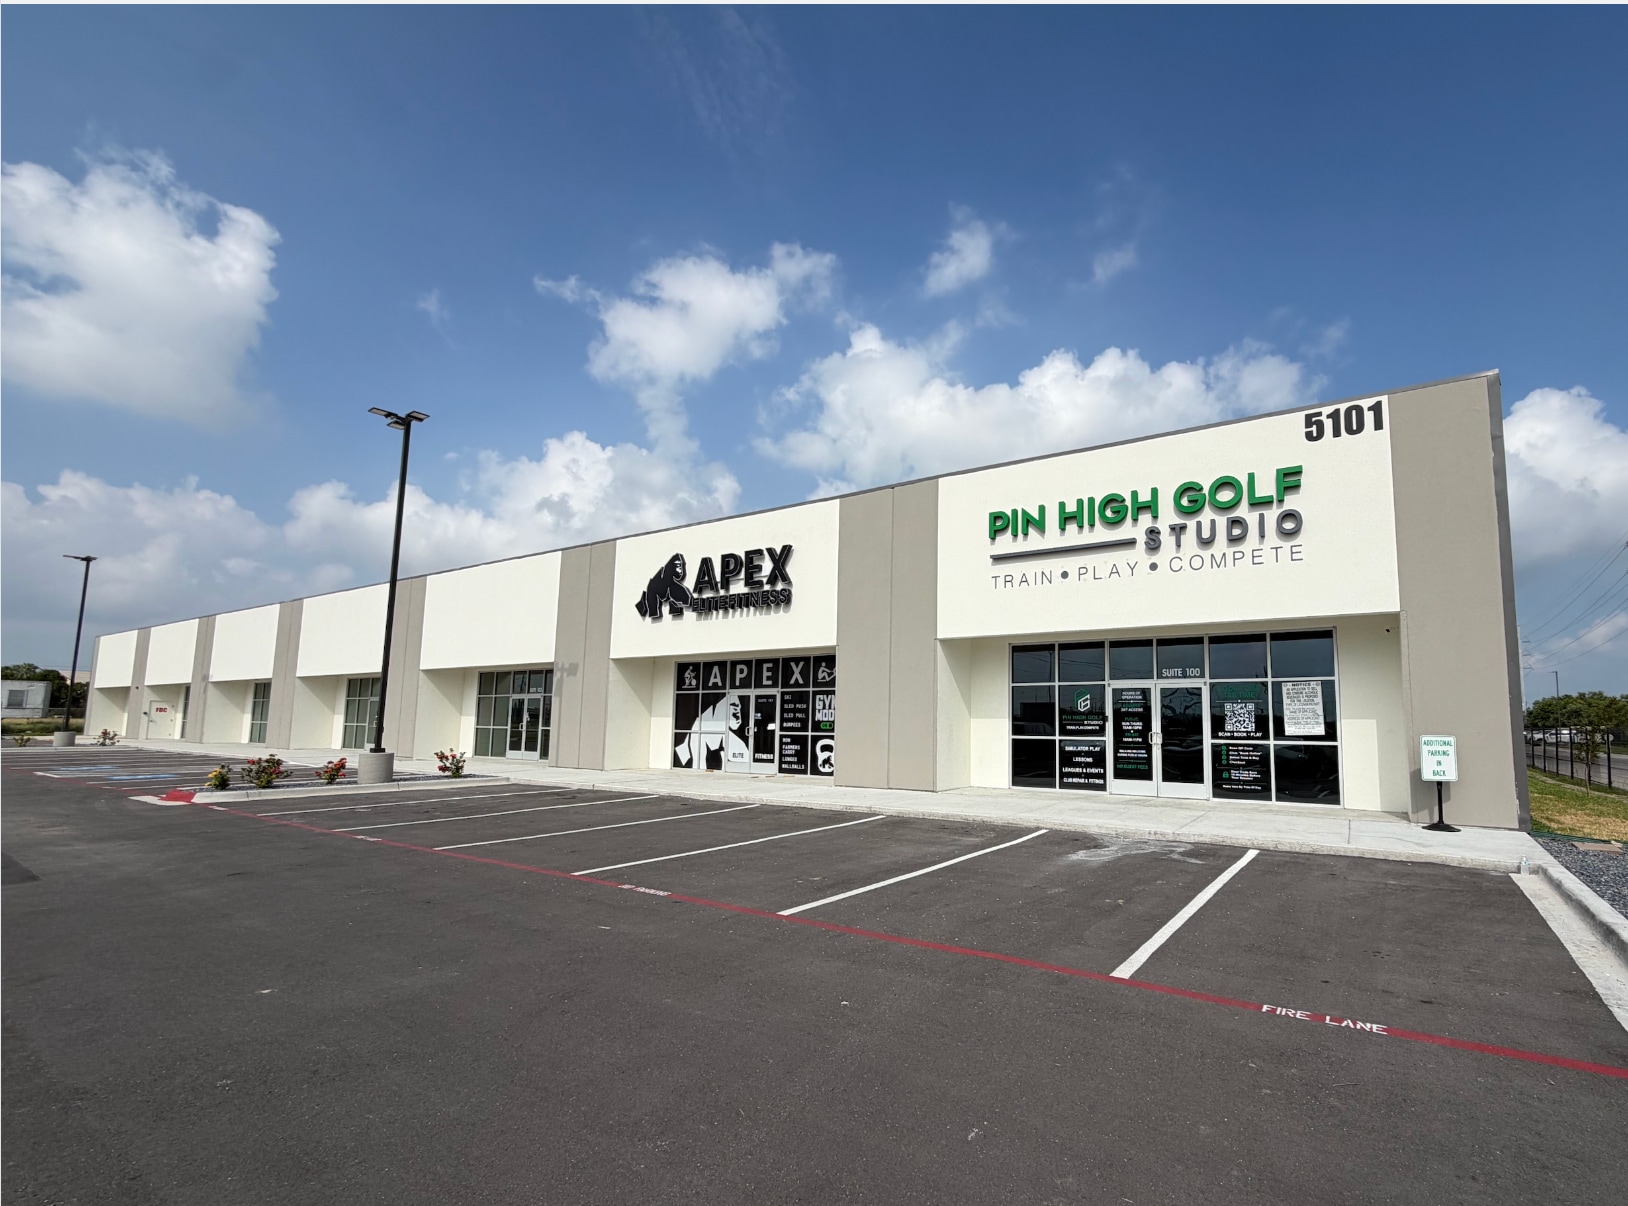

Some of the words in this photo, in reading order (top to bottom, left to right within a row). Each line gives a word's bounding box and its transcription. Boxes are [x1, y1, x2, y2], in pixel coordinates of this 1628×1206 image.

[1305, 400, 1383, 442] 5101
[989, 504, 1046, 540] PIN
[1058, 487, 1158, 534] HIGH
[1173, 465, 1302, 514] GOLF
[1144, 509, 1303, 550] STUDIO
[693, 544, 793, 594] APEX
[991, 570, 1053, 589] TRAIN
[1078, 561, 1138, 581] PLAY
[1169, 544, 1303, 573] COMPETE
[1162, 668, 1183, 677] SUITE
[1185, 668, 1201, 676] 100
[815, 710, 835, 721] MOD
[1261, 1004, 1312, 1021] FIRE
[1325, 1016, 1388, 1035] LANE
